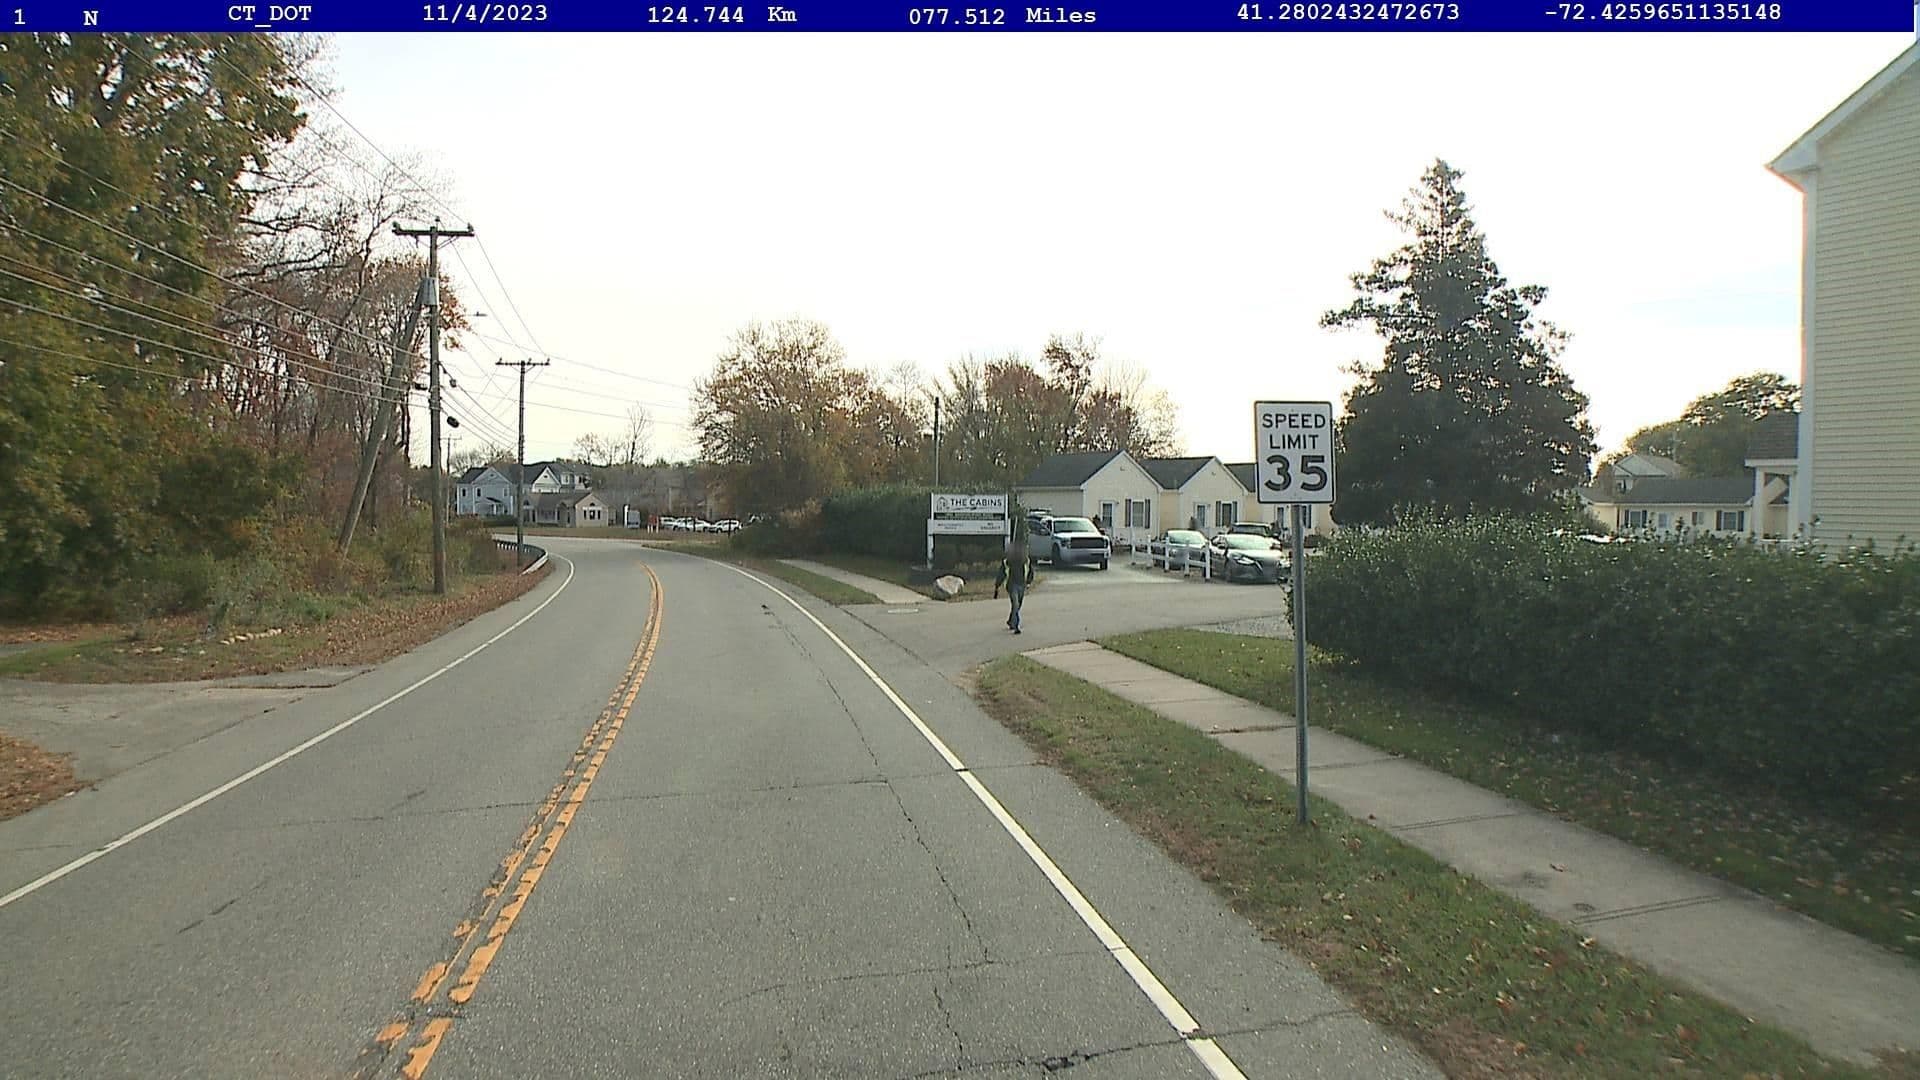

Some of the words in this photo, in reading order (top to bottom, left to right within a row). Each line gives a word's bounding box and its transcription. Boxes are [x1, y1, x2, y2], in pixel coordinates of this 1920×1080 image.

[1262, 413, 1326, 428] SPEED
[1269, 434, 1319, 449] LIMIT
[1264, 454, 1328, 491] 35
[950, 498, 967, 506] THE
[969, 498, 1002, 507] CABINS
